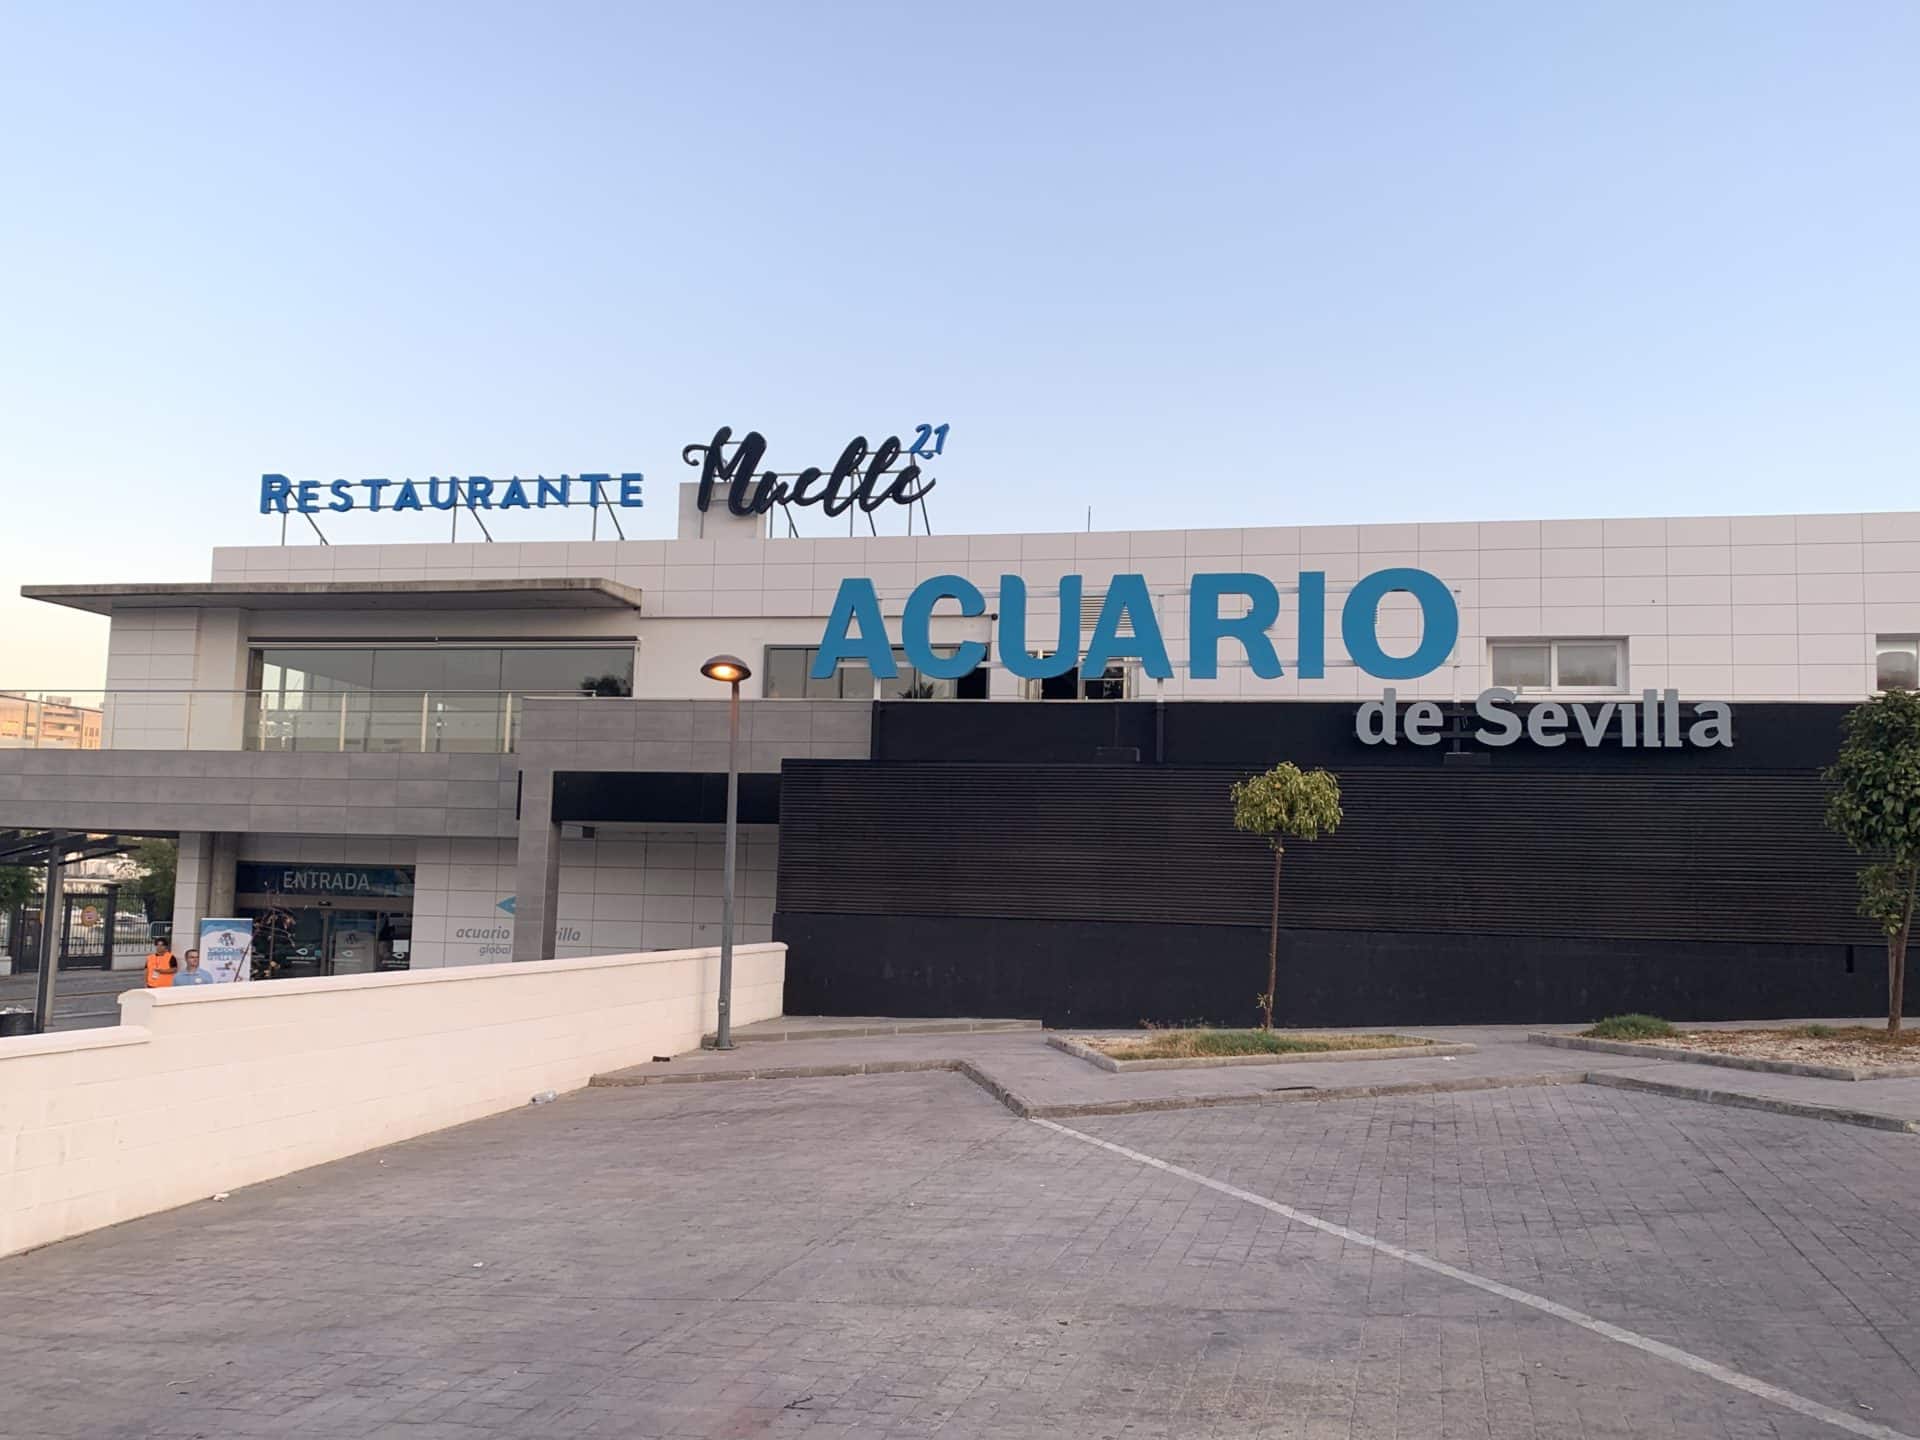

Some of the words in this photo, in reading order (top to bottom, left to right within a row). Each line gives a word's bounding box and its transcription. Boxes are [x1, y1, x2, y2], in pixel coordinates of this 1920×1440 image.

[682, 425, 937, 518] Muelle
[910, 423, 950, 460] 21
[810, 567, 1461, 681] ACUARIO
[1355, 687, 1444, 747] de
[1474, 686, 1734, 748] Sevilla
[283, 871, 370, 891] ENTRADA
[456, 925, 510, 940] acuario
